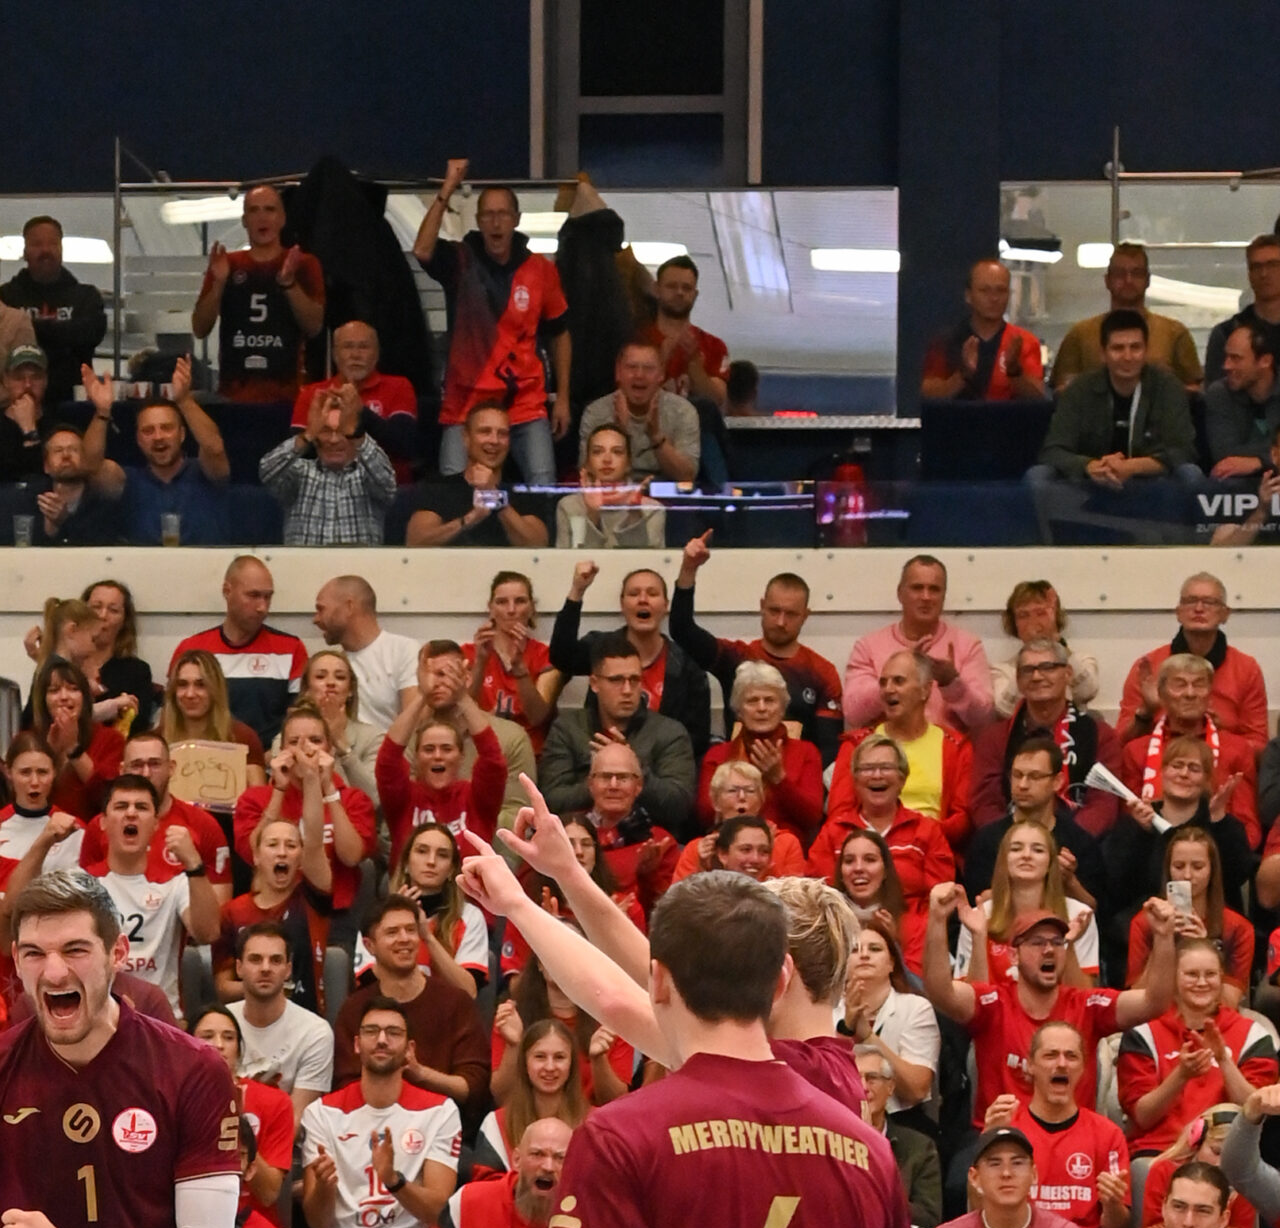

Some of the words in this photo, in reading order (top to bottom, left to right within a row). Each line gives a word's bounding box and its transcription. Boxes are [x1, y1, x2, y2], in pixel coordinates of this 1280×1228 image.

[248, 293, 268, 323] 5
[246, 335, 283, 347] OSPA
[1197, 494, 1259, 517] VIP
[124, 957, 157, 972] SPA
[668, 1119, 870, 1171] MERRYWEATHER
[77, 1164, 99, 1223] 1
